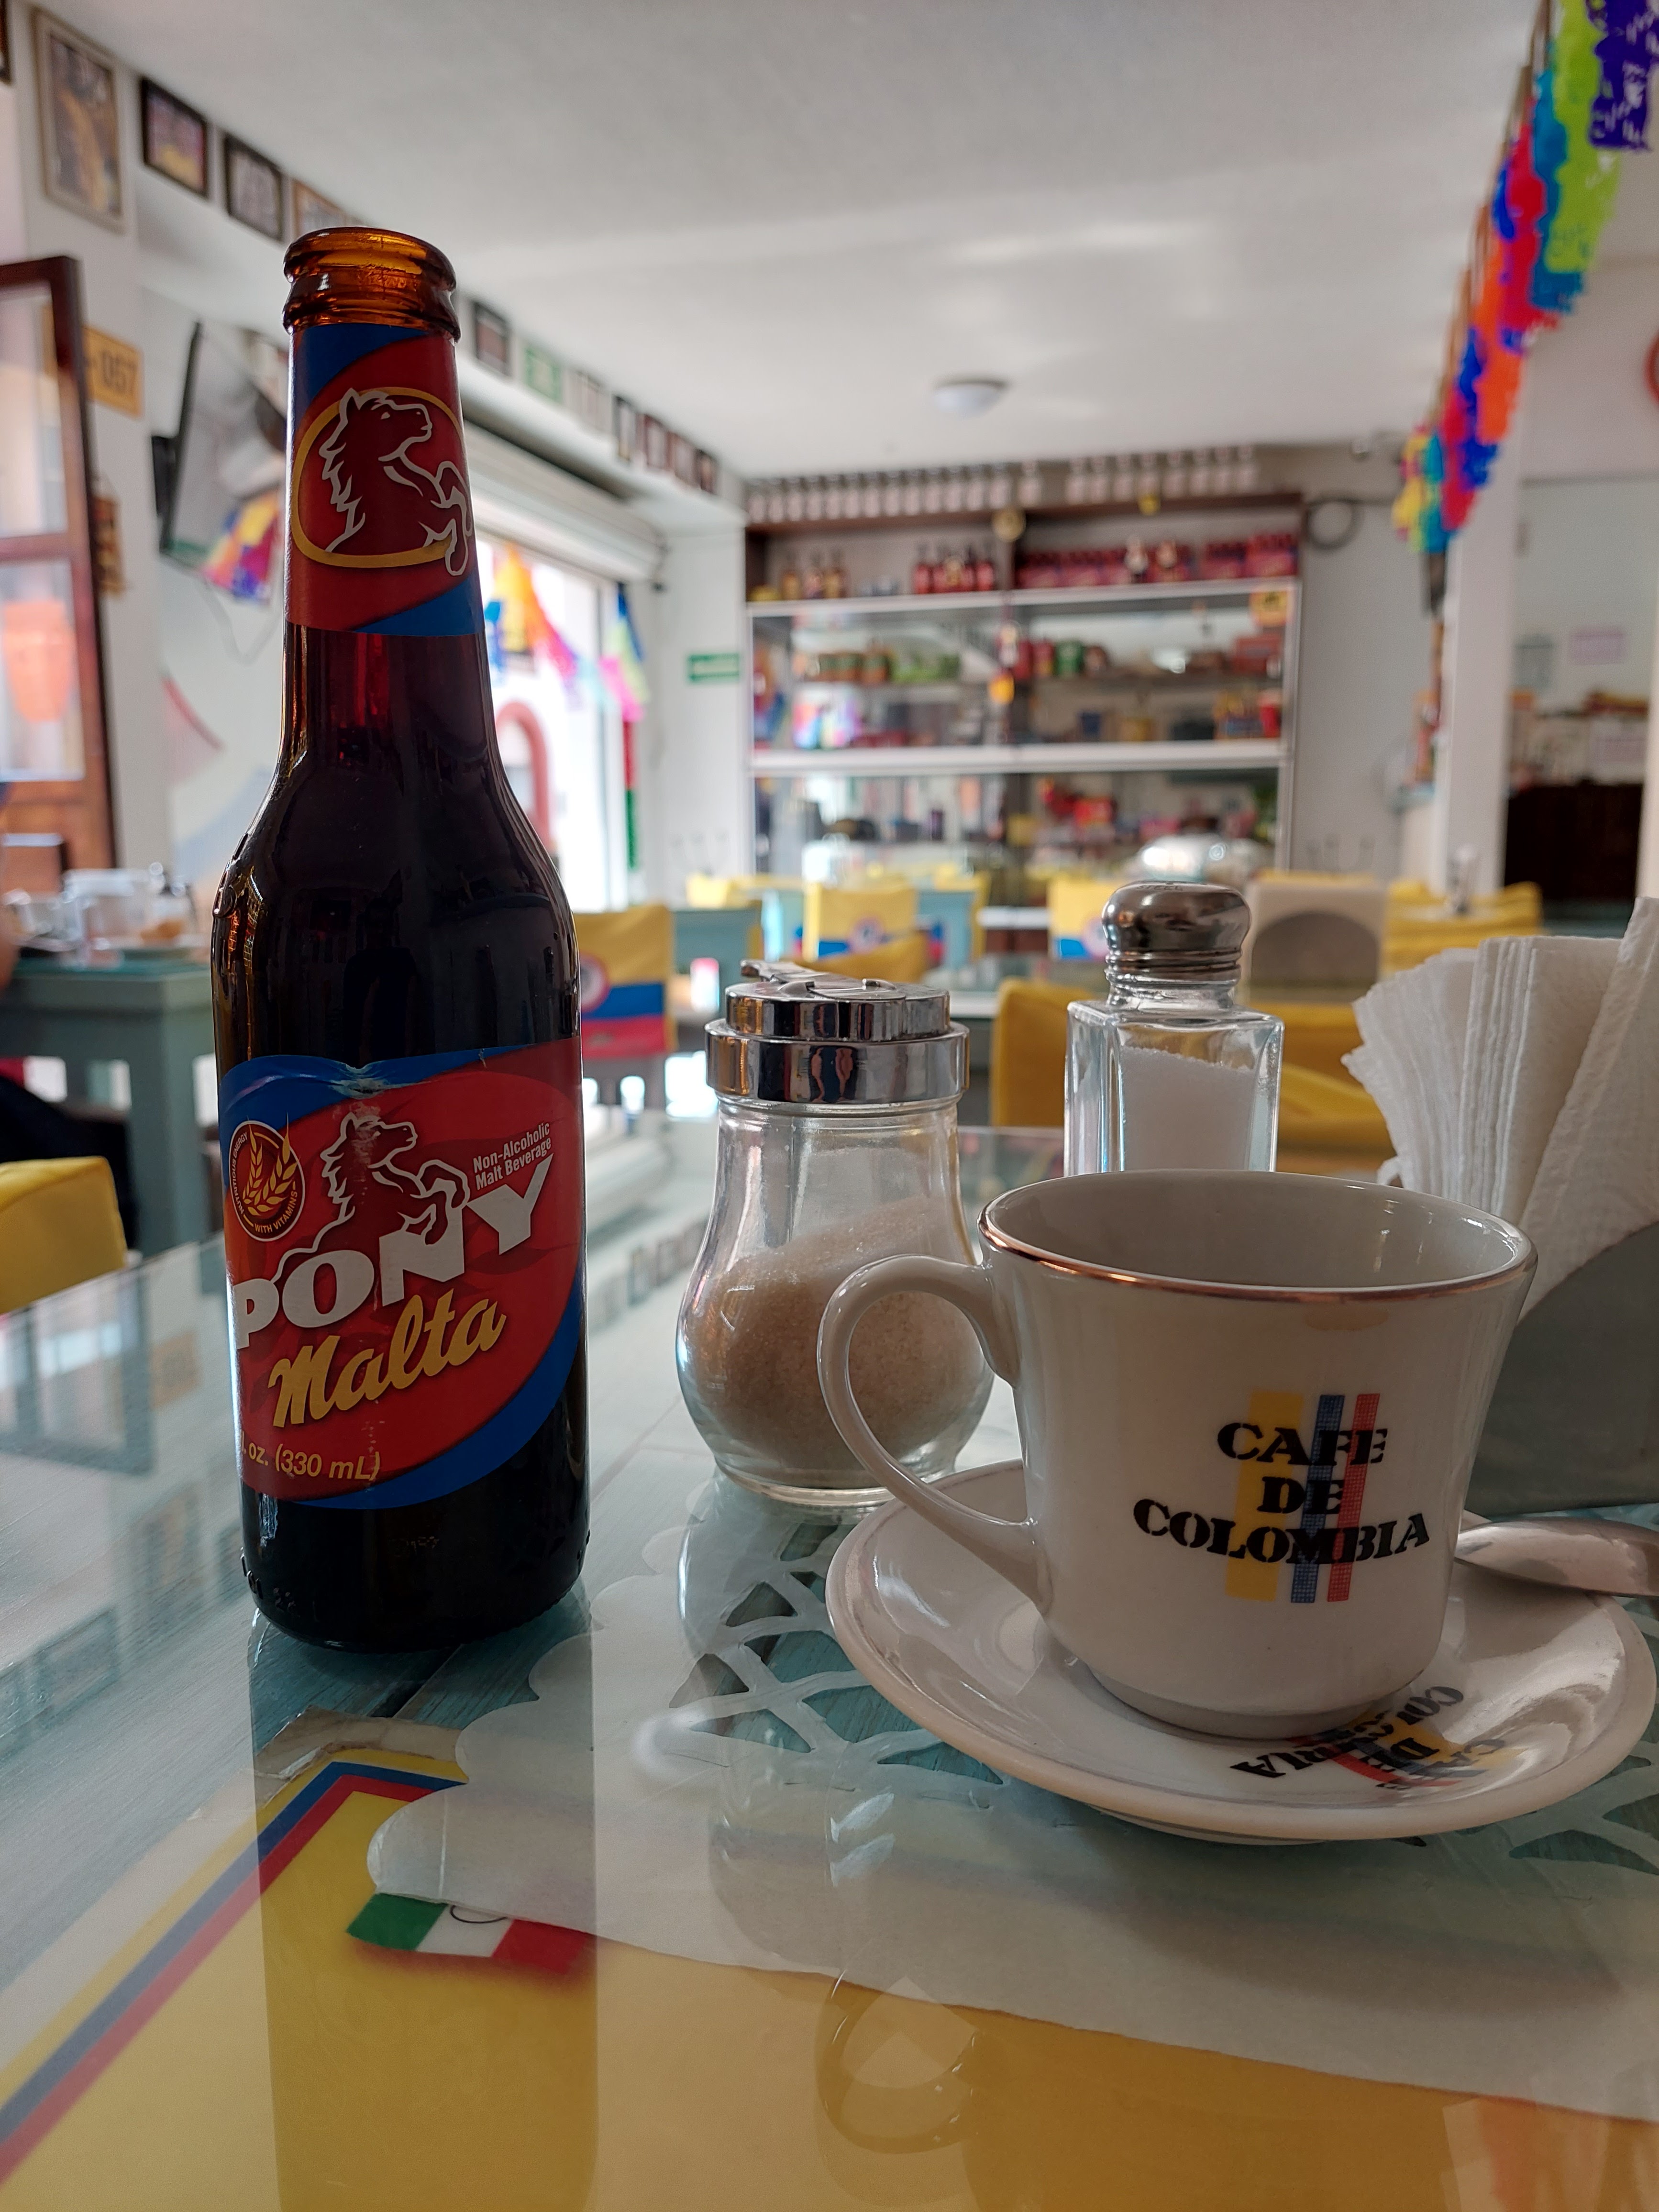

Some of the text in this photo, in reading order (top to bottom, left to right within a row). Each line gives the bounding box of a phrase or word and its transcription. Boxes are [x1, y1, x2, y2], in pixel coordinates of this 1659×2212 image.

[231, 1131, 248, 1215] NUTRITIOUS ENERGY
[473, 1122, 550, 1174] Non-Alcoholic
[475, 1138, 552, 1191] Malt Beverage
[254, 1190, 298, 1234] WITH VITAMINS
[233, 1153, 554, 1350] PONY
[268, 1288, 507, 1428] Malta
[248, 1442, 269, 1466] oz.
[275, 1443, 323, 1478] (330
[328, 1450, 381, 1482] mL)
[1217, 1422, 1388, 1466] CAFE
[1257, 1476, 1346, 1515] DE
[1133, 1498, 1430, 1564] COLOMBIA
